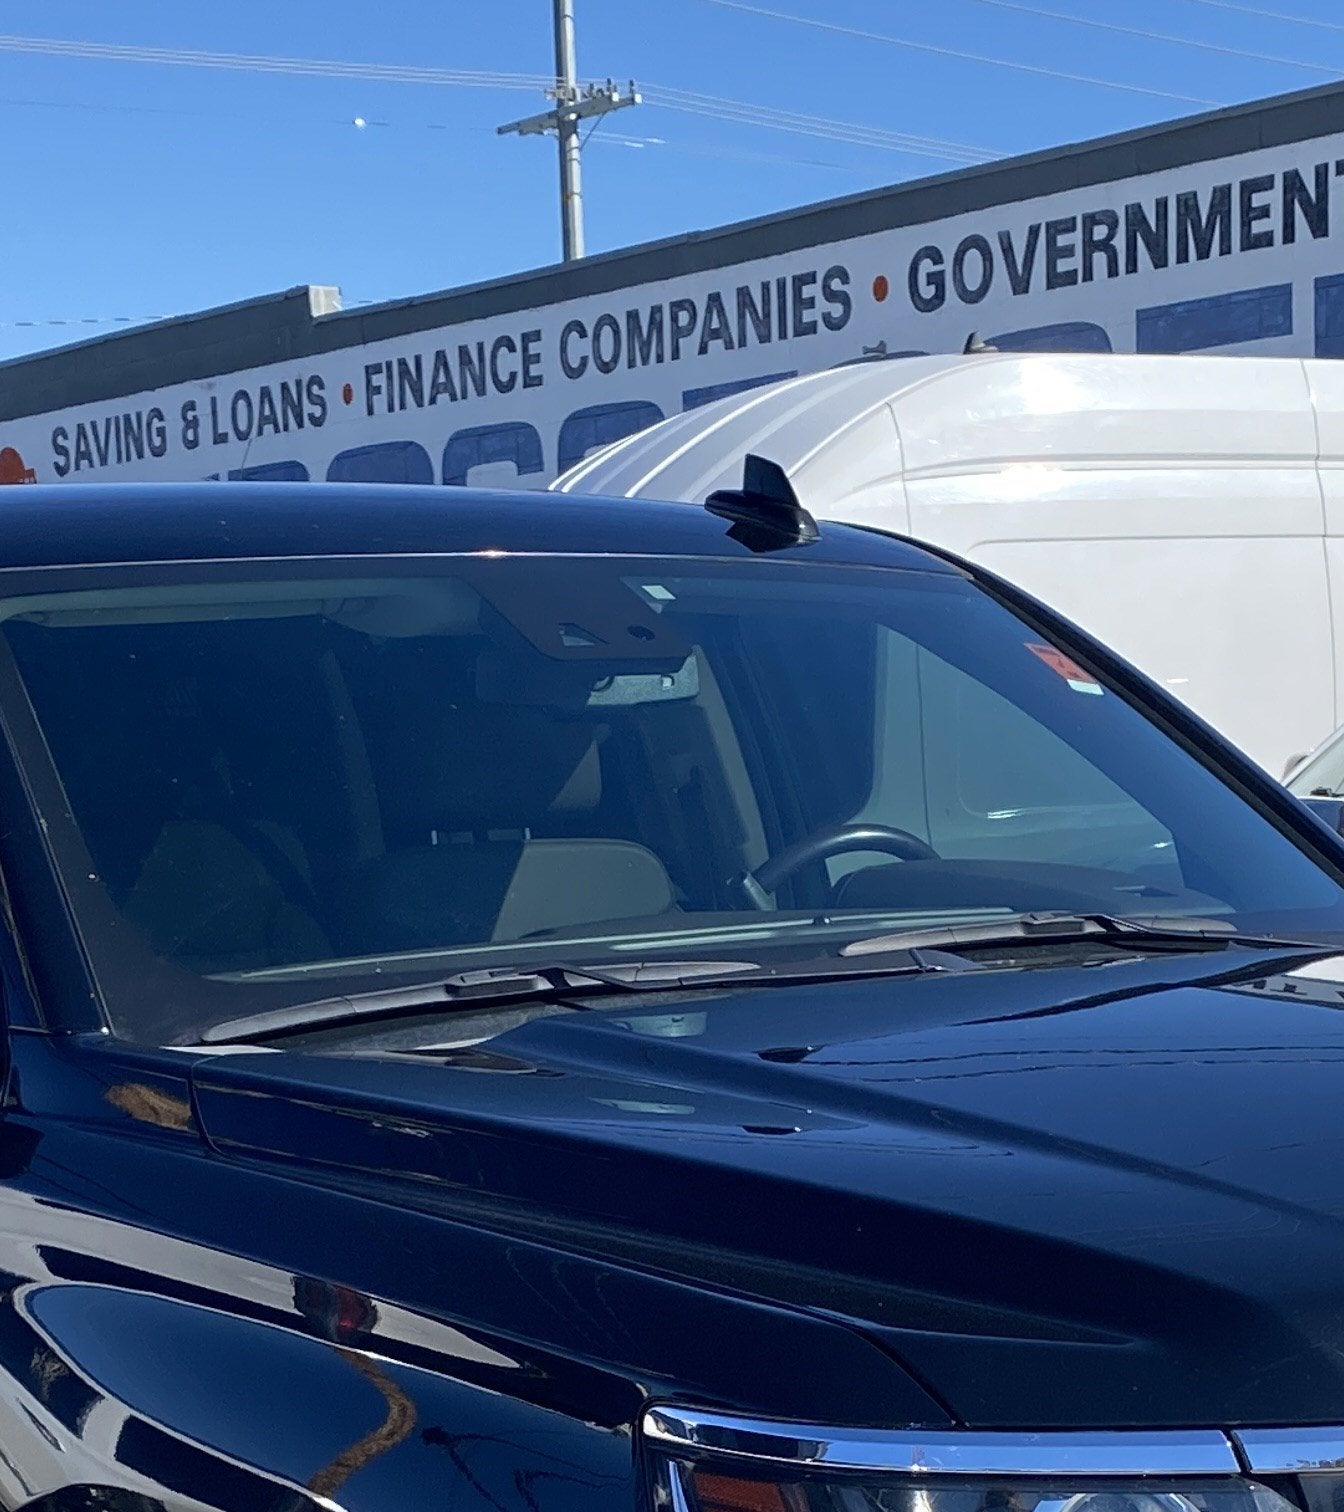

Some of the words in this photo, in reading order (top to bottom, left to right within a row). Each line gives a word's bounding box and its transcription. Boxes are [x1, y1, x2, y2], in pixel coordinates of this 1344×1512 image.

[52, 407, 166, 477] SAVING
[181, 399, 199, 450] &
[212, 374, 327, 446] LOANS
[364, 329, 543, 416] FINANCE
[560, 265, 852, 380] COMPANIES
